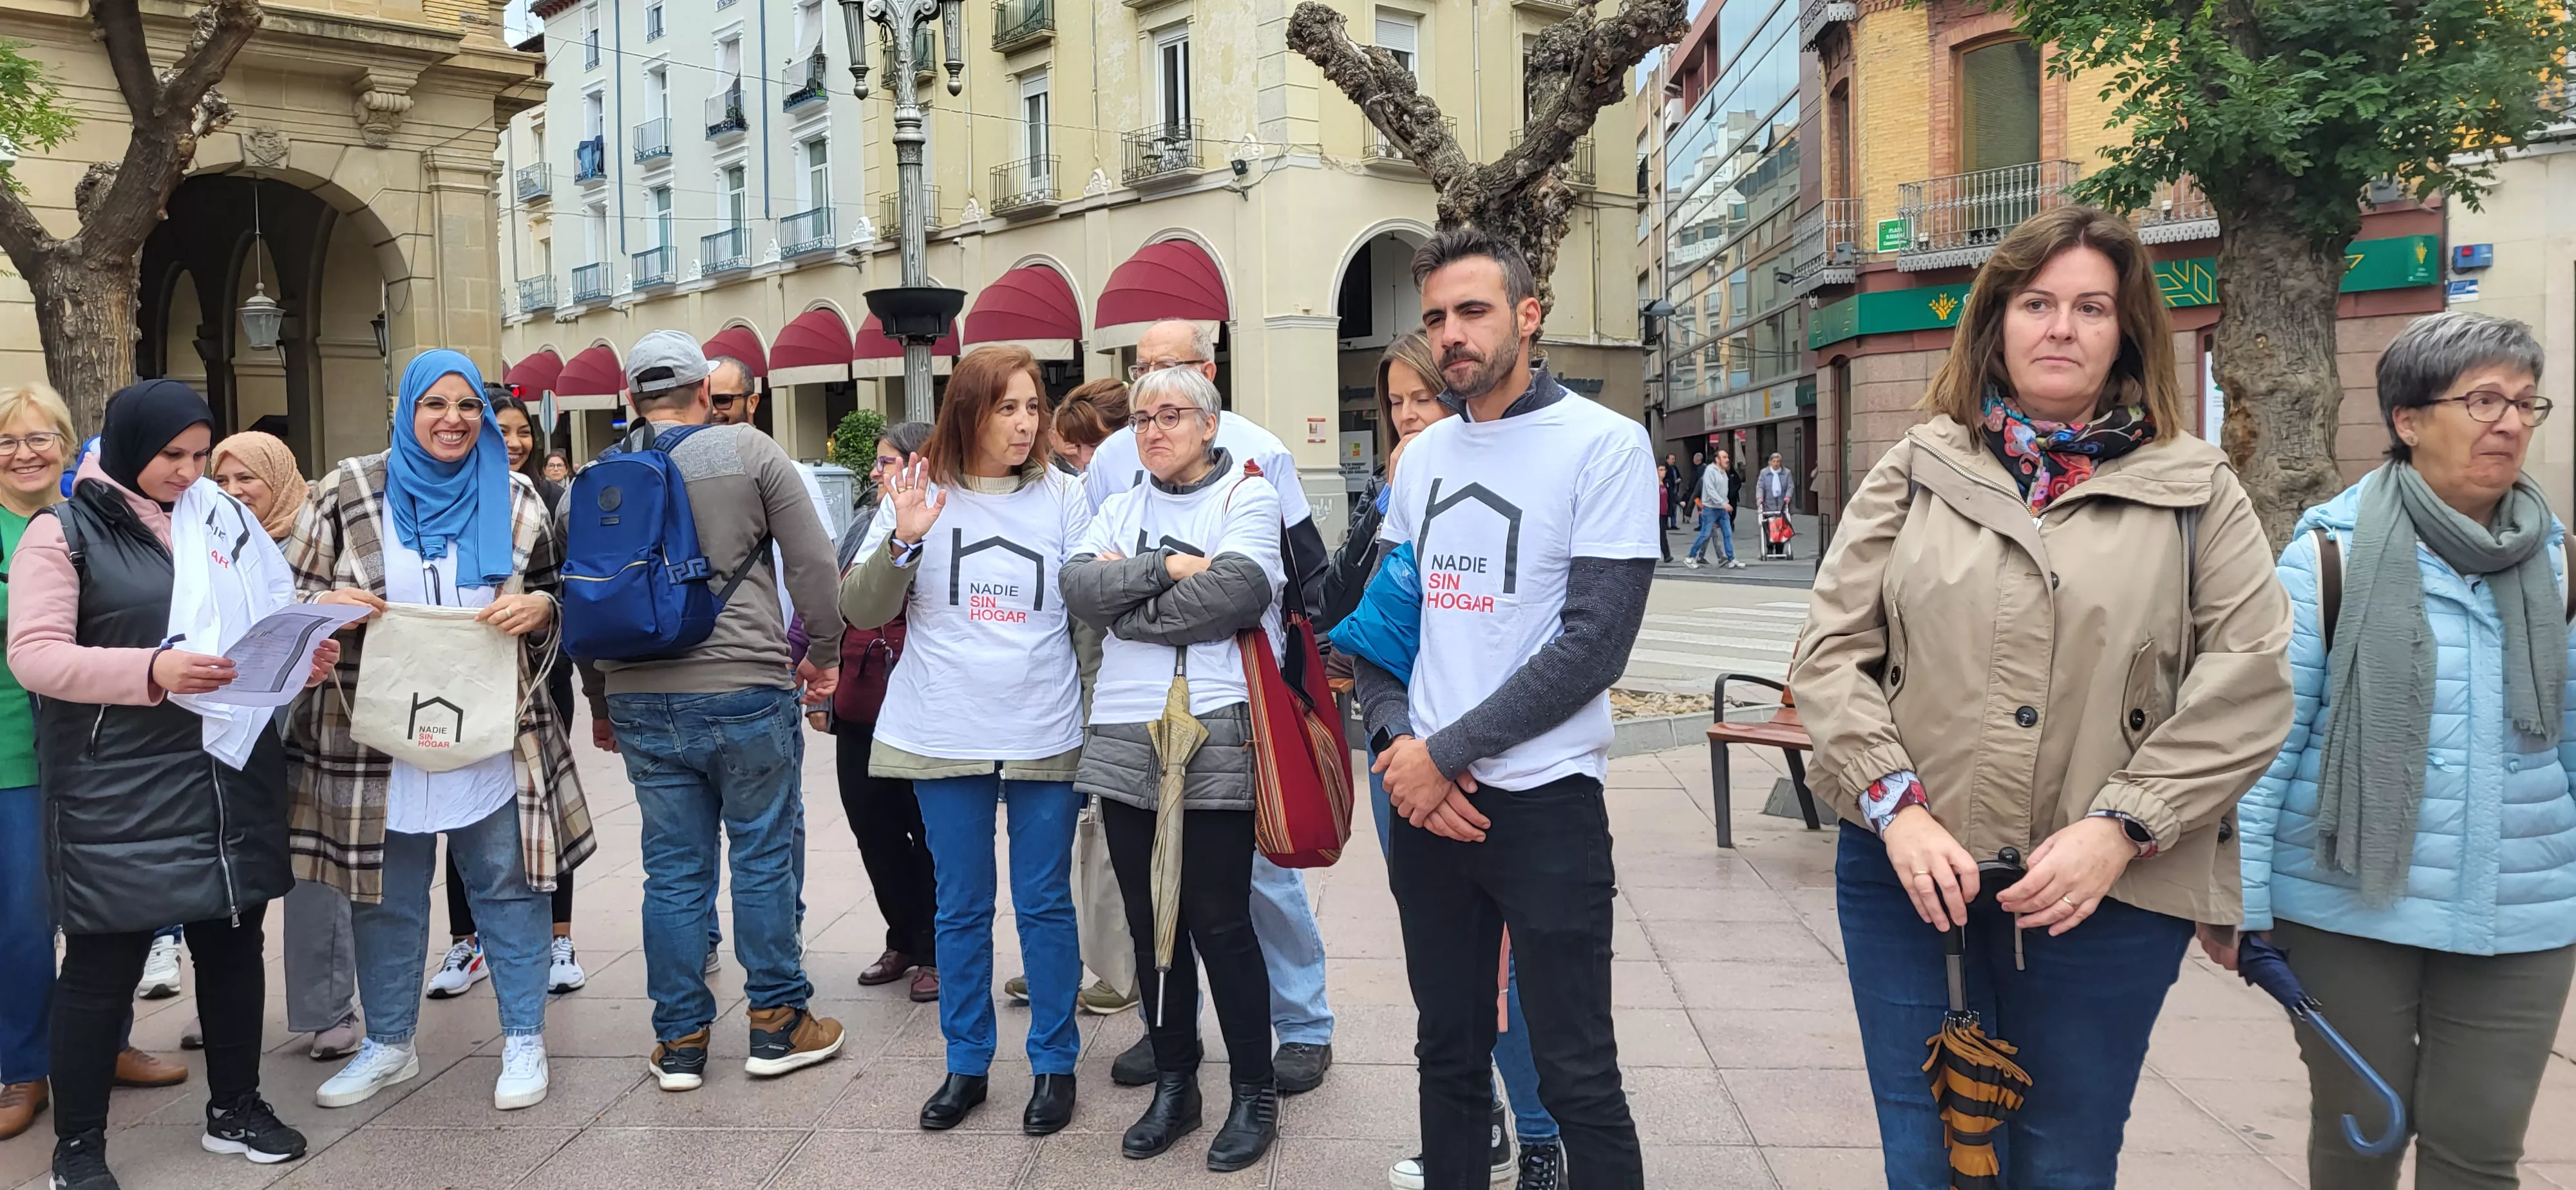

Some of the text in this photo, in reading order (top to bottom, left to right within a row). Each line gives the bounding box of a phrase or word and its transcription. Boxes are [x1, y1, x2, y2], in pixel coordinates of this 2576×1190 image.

[1431, 554, 1487, 573] NADIE
[1428, 572, 1461, 590] SIN
[970, 582, 1019, 596] NADIE
[970, 595, 996, 608] SIN
[1427, 592, 1494, 613] HOGAR
[970, 609, 1027, 623] HOGAR
[419, 725, 448, 734] NADIE
